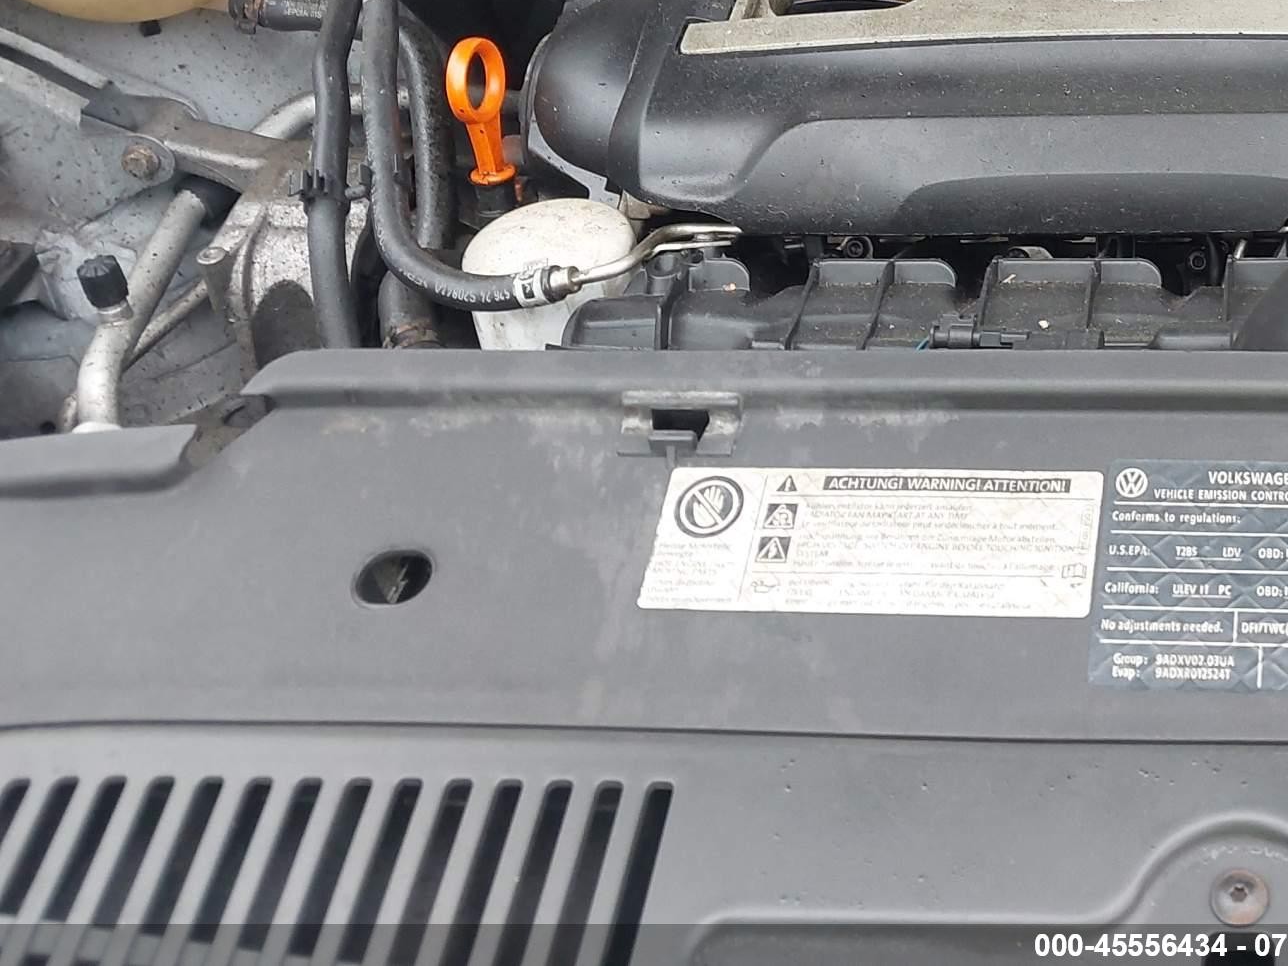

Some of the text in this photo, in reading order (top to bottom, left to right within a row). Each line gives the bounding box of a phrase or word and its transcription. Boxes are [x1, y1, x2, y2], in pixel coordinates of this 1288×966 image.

[828, 476, 1067, 493] ACHTUNG! WARNING! ATTENTION!
[1153, 488, 1195, 500] VEHICLE
[1198, 489, 1247, 501] EMISSION
[1111, 510, 1242, 526] Conforms to regulations:
[1222, 546, 1242, 558] LDV
[1104, 581, 1160, 594] California:
[1172, 584, 1197, 595] ULEV
[1218, 585, 1232, 596] PC
[1101, 619, 1225, 634] No adjustments needed.
[1112, 653, 1149, 667] Group:
[1111, 666, 1141, 681] Evap:
